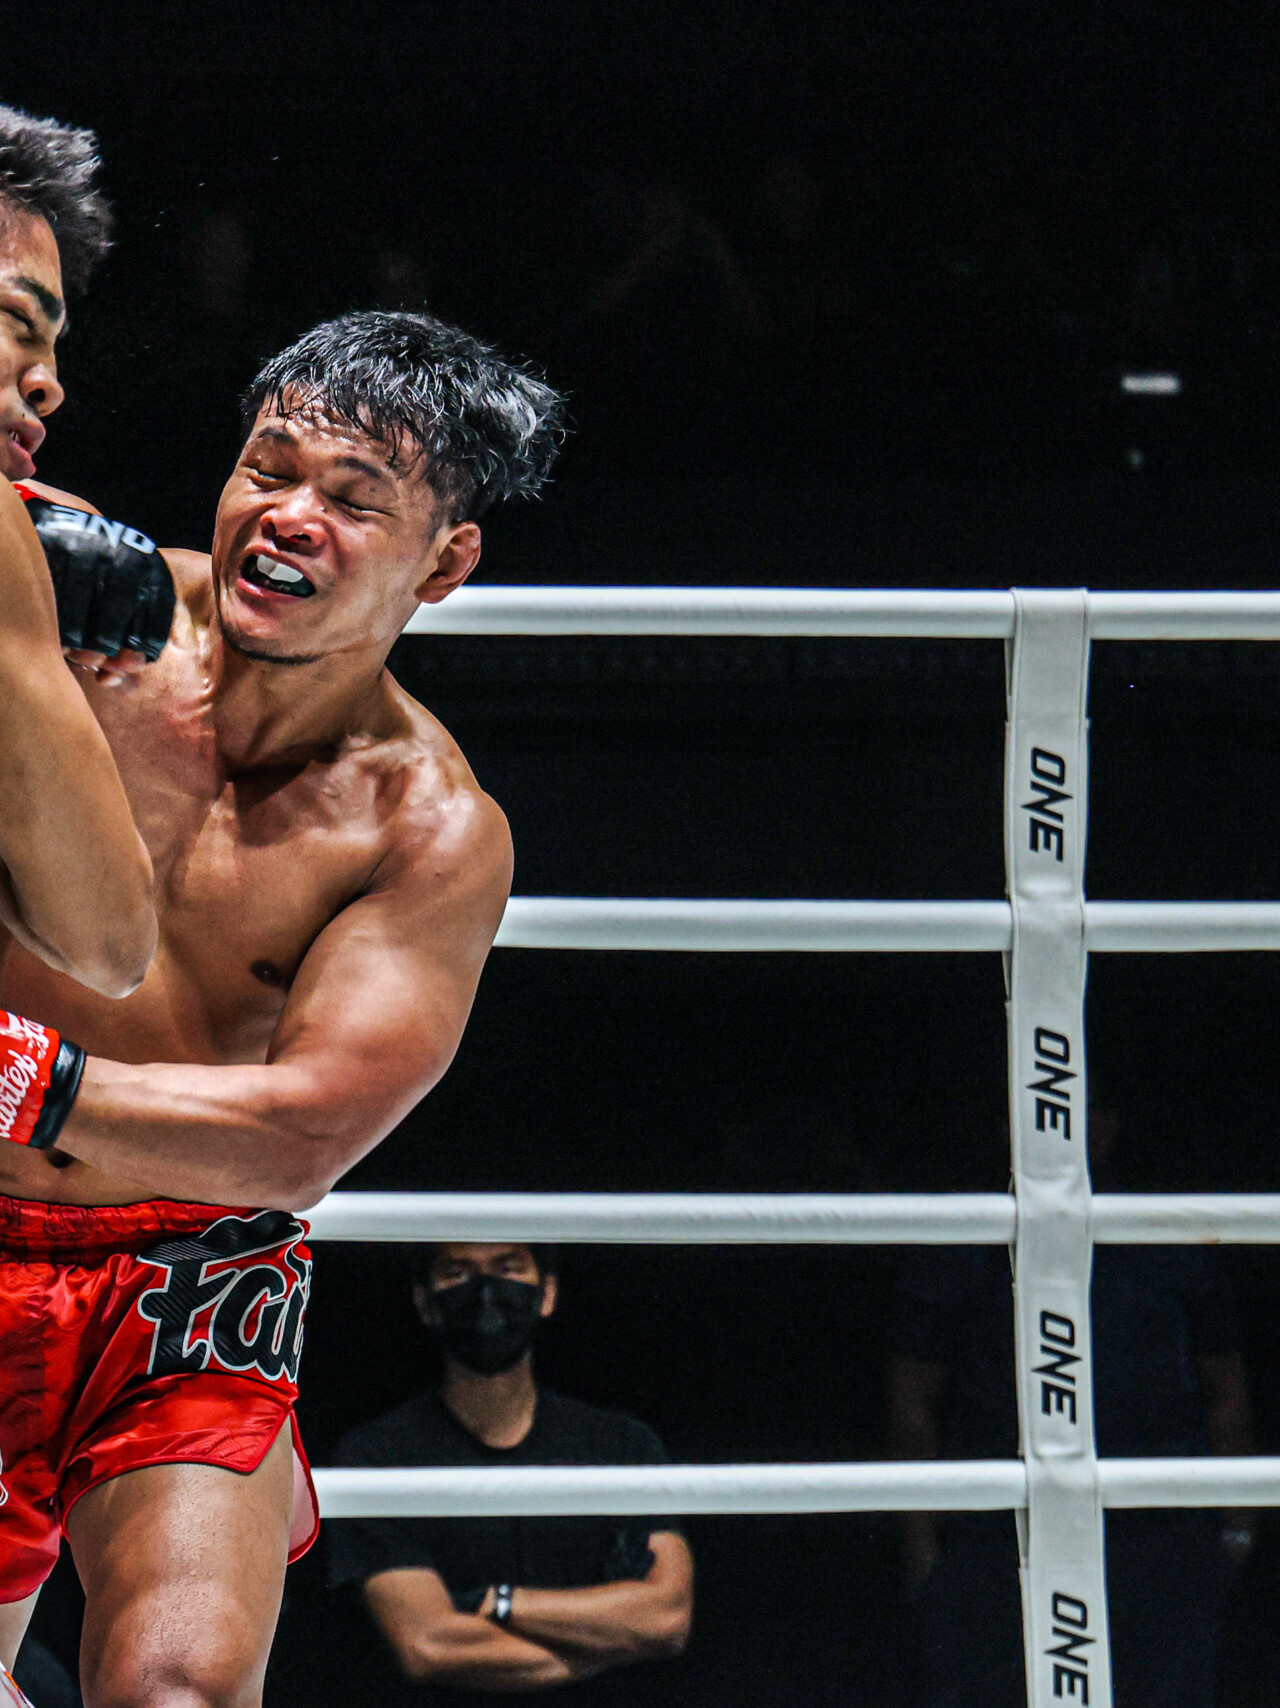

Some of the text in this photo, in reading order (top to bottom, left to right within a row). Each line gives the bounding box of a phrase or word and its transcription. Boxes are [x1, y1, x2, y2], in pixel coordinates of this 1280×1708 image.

[1020, 746, 1074, 862] ONE
[1025, 1026, 1078, 1141] ONE
[1031, 1310, 1083, 1425] ONE
[1044, 1592, 1097, 1706] ONE
